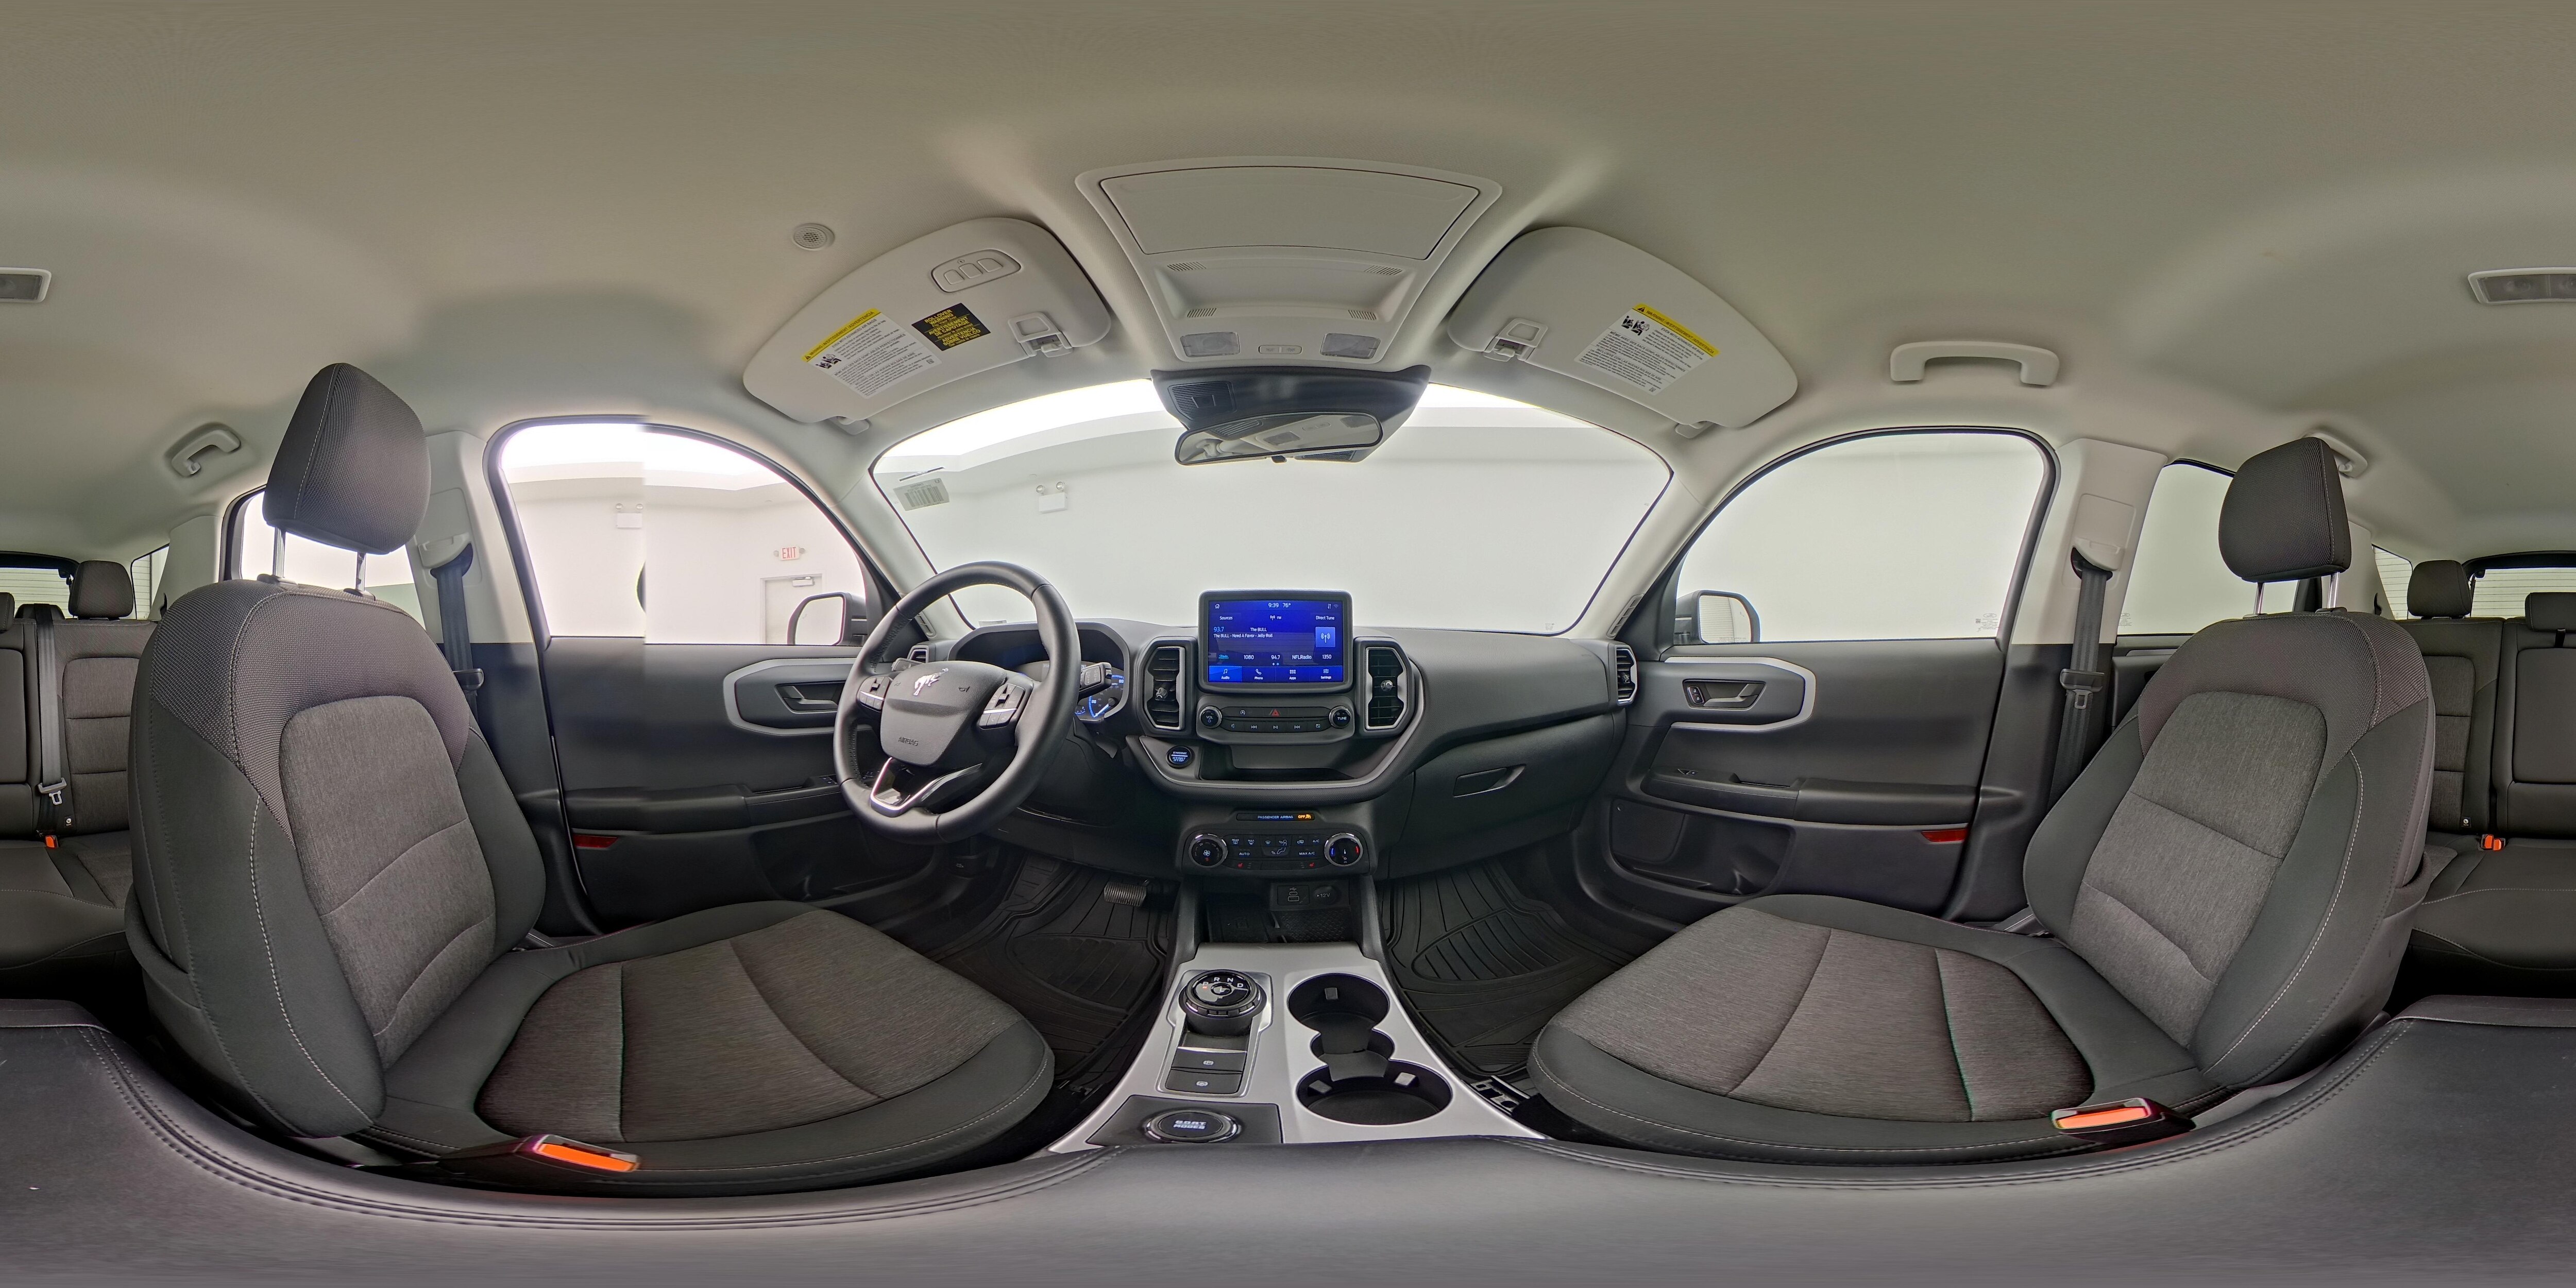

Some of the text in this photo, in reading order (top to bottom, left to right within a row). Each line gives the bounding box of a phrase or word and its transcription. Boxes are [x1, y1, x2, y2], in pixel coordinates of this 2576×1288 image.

[924, 309, 952, 323] ROLLOVER
[929, 313, 954, 325] WARNING
[1646, 310, 1665, 322] WARNING
[927, 316, 969, 334] AVERTISSEMENT
[941, 320, 969, 333] CAPOTAGE
[941, 327, 976, 342] ADVERTENCIA
[942, 337, 960, 345] SOBRE
[959, 329, 981, 338] VUELCO
[782, 547, 796, 558] EXIT
[897, 737, 919, 747] AIRBAG
